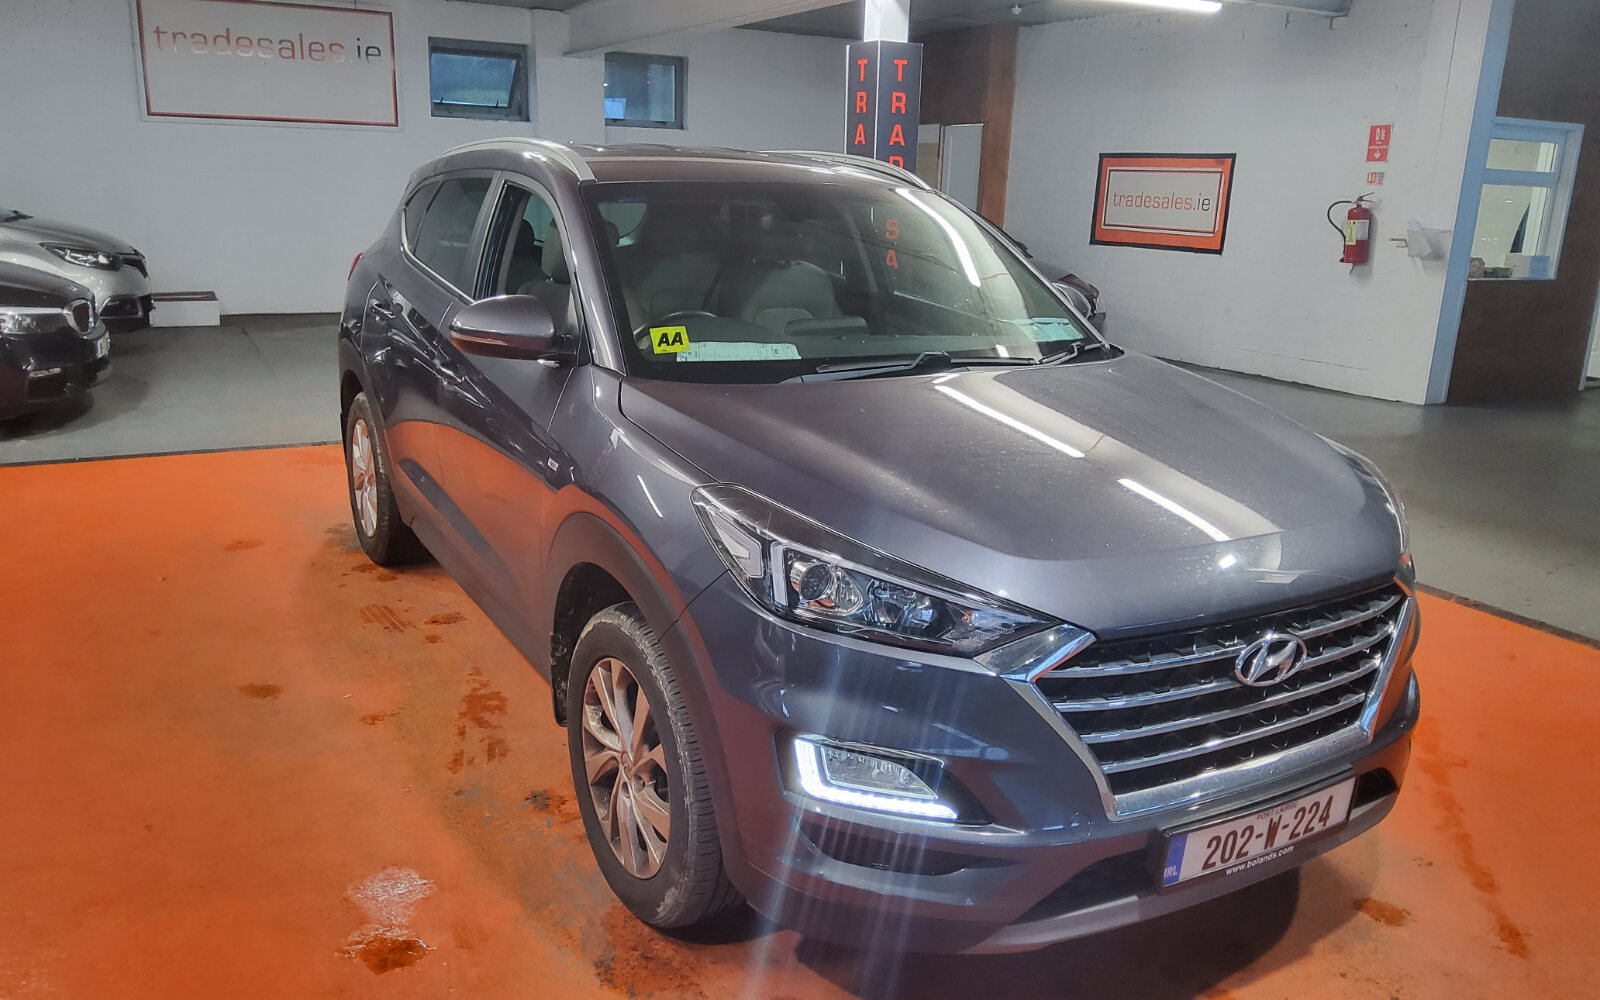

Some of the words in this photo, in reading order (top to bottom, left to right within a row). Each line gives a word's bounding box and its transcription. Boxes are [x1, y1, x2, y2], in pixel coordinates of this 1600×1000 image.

[153, 25, 382, 64] tradesales.ie
[1113, 190, 1211, 212] tradesales.ie
[657, 331, 684, 348] AA
[1202, 795, 1334, 871] 202-W-224
[1163, 865, 1178, 879] IRL
[1226, 845, 1294, 876] www.bolands.com
